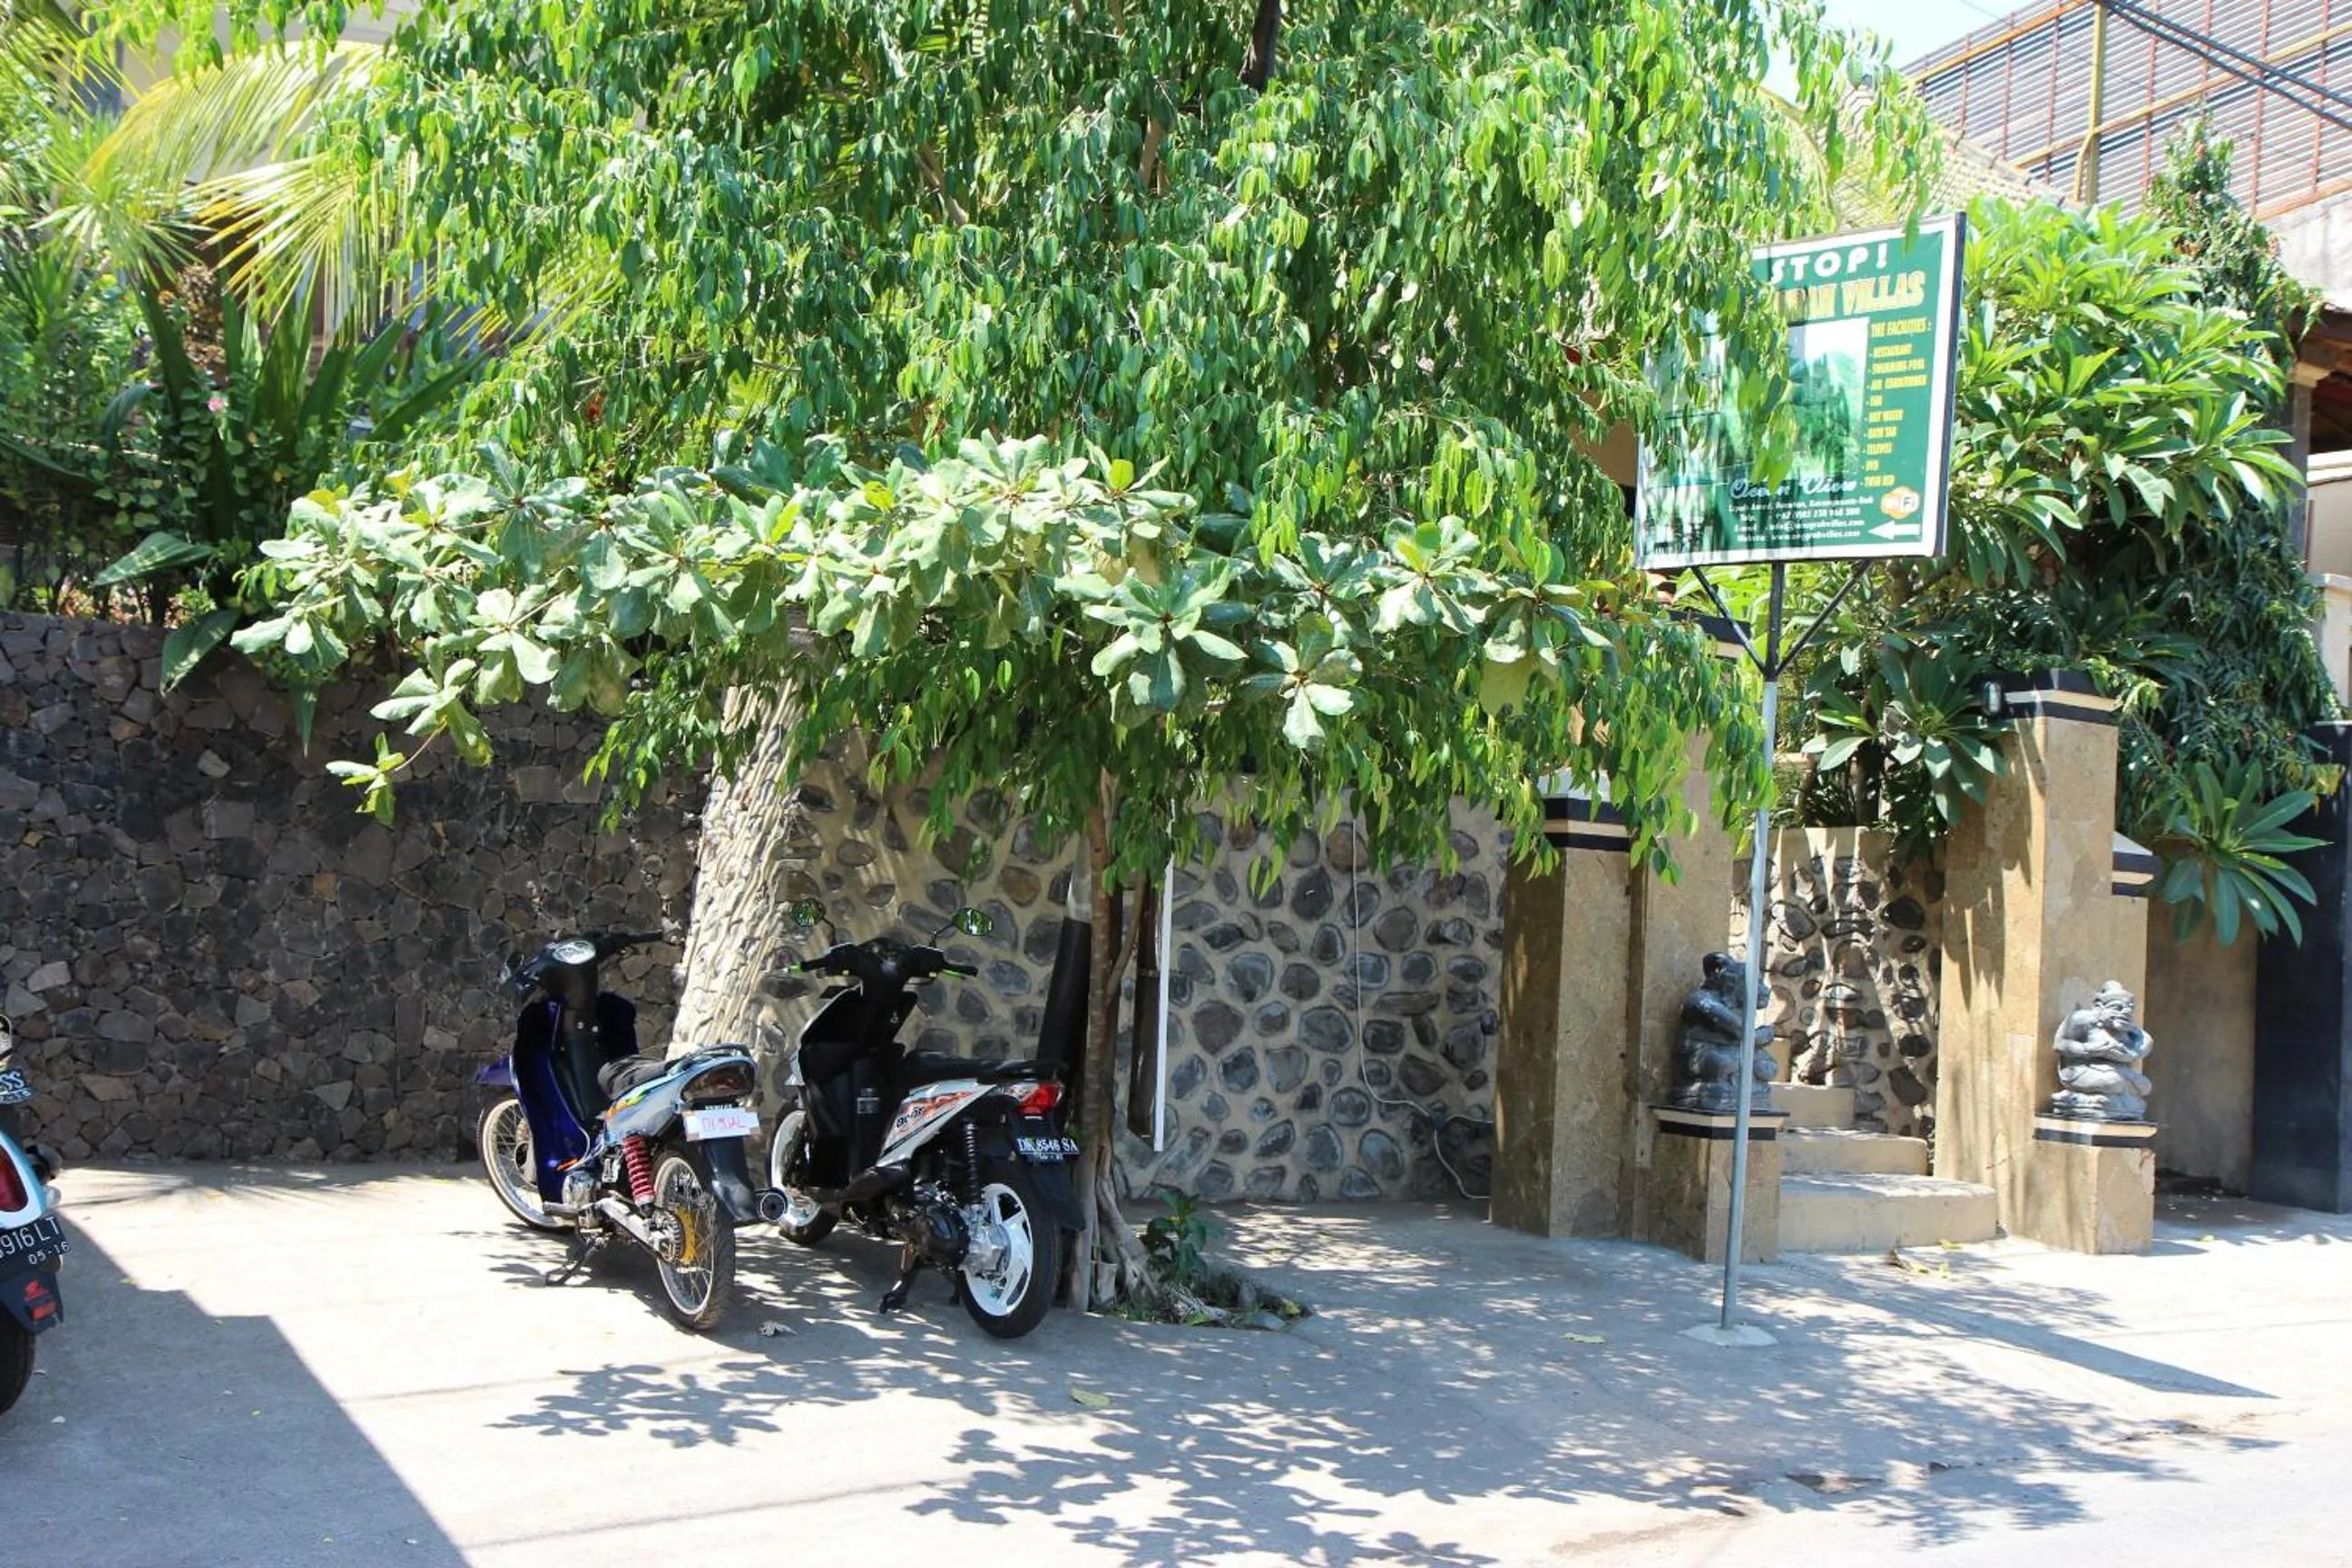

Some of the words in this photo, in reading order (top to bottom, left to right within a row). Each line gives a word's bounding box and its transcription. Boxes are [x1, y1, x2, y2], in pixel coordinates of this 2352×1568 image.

[1771, 242, 1888, 284] STOP!
[1841, 270, 1926, 316] VILLAS
[34, 1216, 59, 1241] LT
